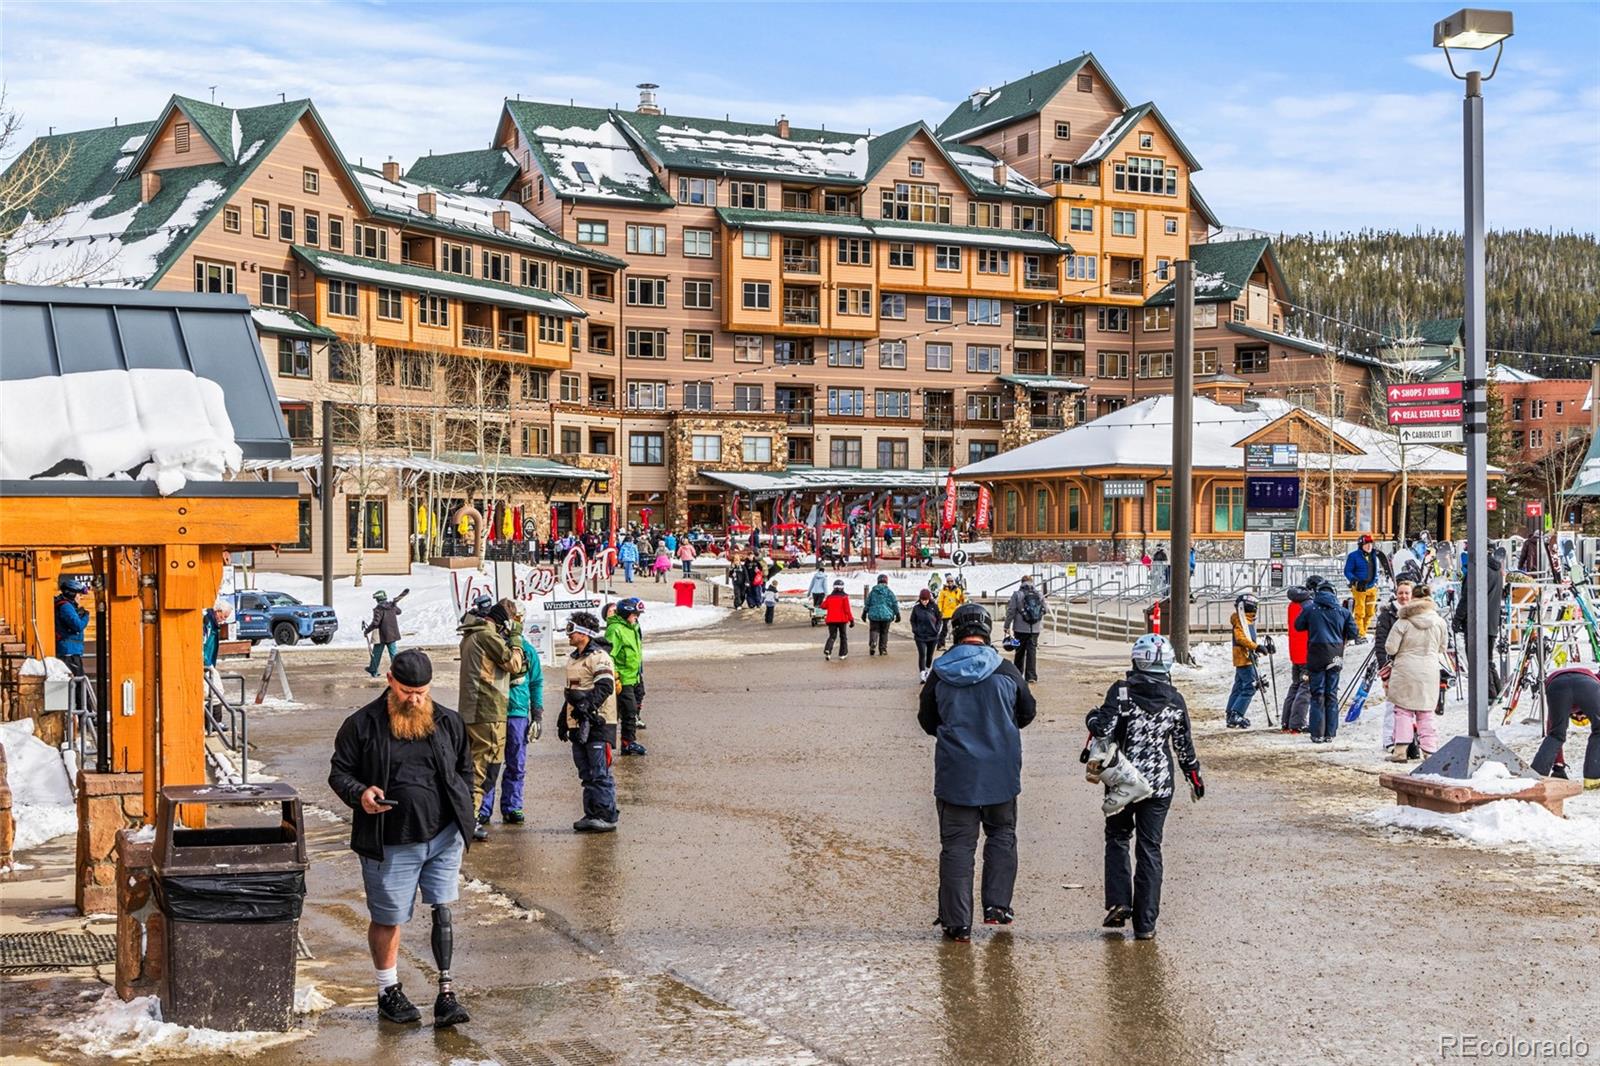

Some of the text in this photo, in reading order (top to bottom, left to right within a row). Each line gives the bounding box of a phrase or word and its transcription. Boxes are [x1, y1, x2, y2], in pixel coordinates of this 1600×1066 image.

[1401, 388, 1422, 397] SHOPS
[1427, 387, 1450, 396] DINING
[1402, 409, 1460, 419] REAL ESTATE SALES
[1411, 430, 1452, 439] CABRIOLET LIFT
[945, 495, 956, 522] WELLS
[978, 498, 988, 526] WELLS
[545, 601, 572, 609] Winter
